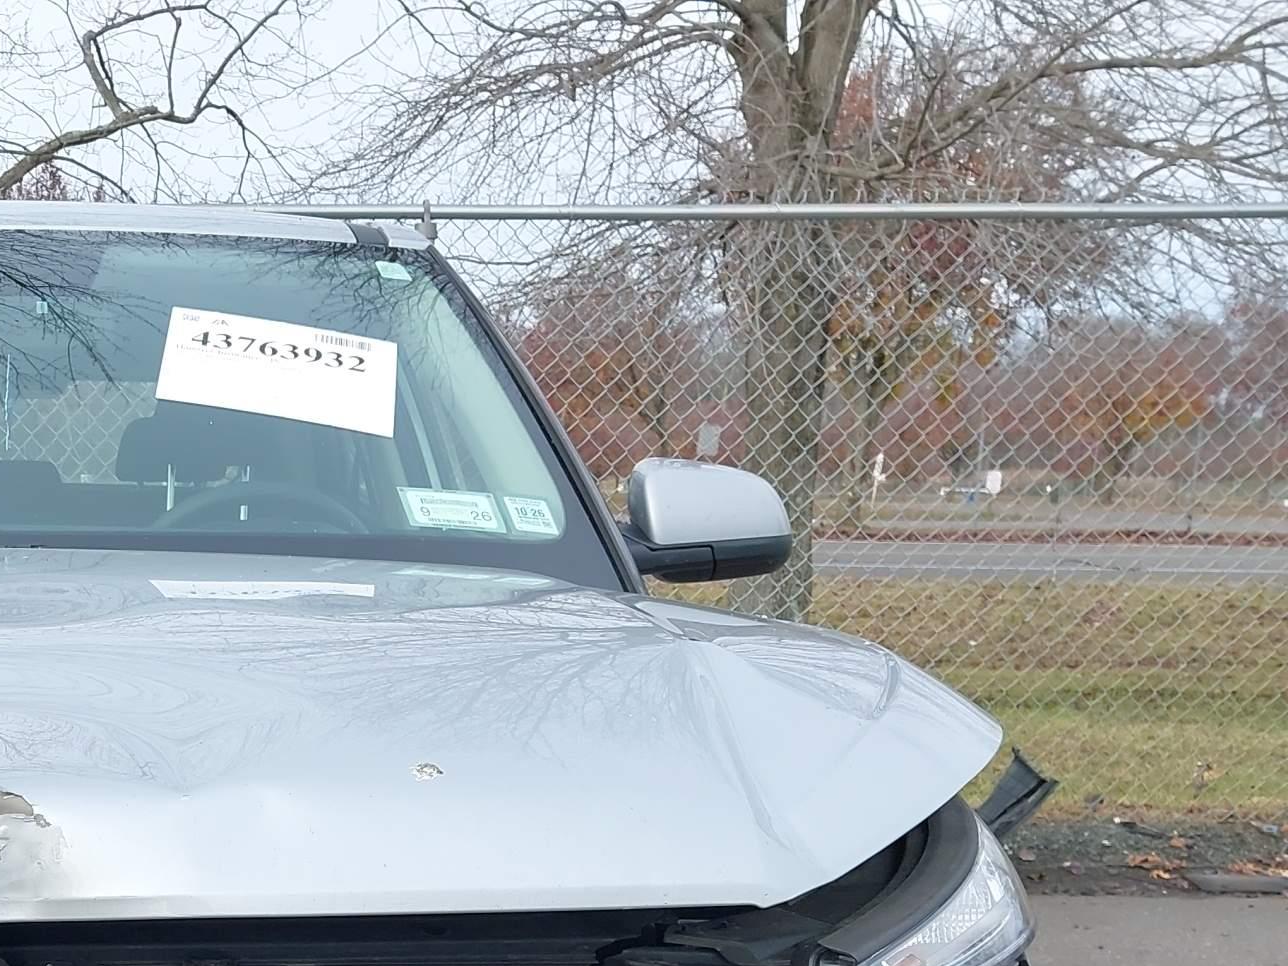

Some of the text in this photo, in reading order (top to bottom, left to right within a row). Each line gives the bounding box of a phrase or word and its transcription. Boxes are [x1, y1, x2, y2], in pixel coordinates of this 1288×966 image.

[191, 331, 367, 373] 43763932
[419, 506, 431, 517] 9
[470, 510, 493, 522] 26
